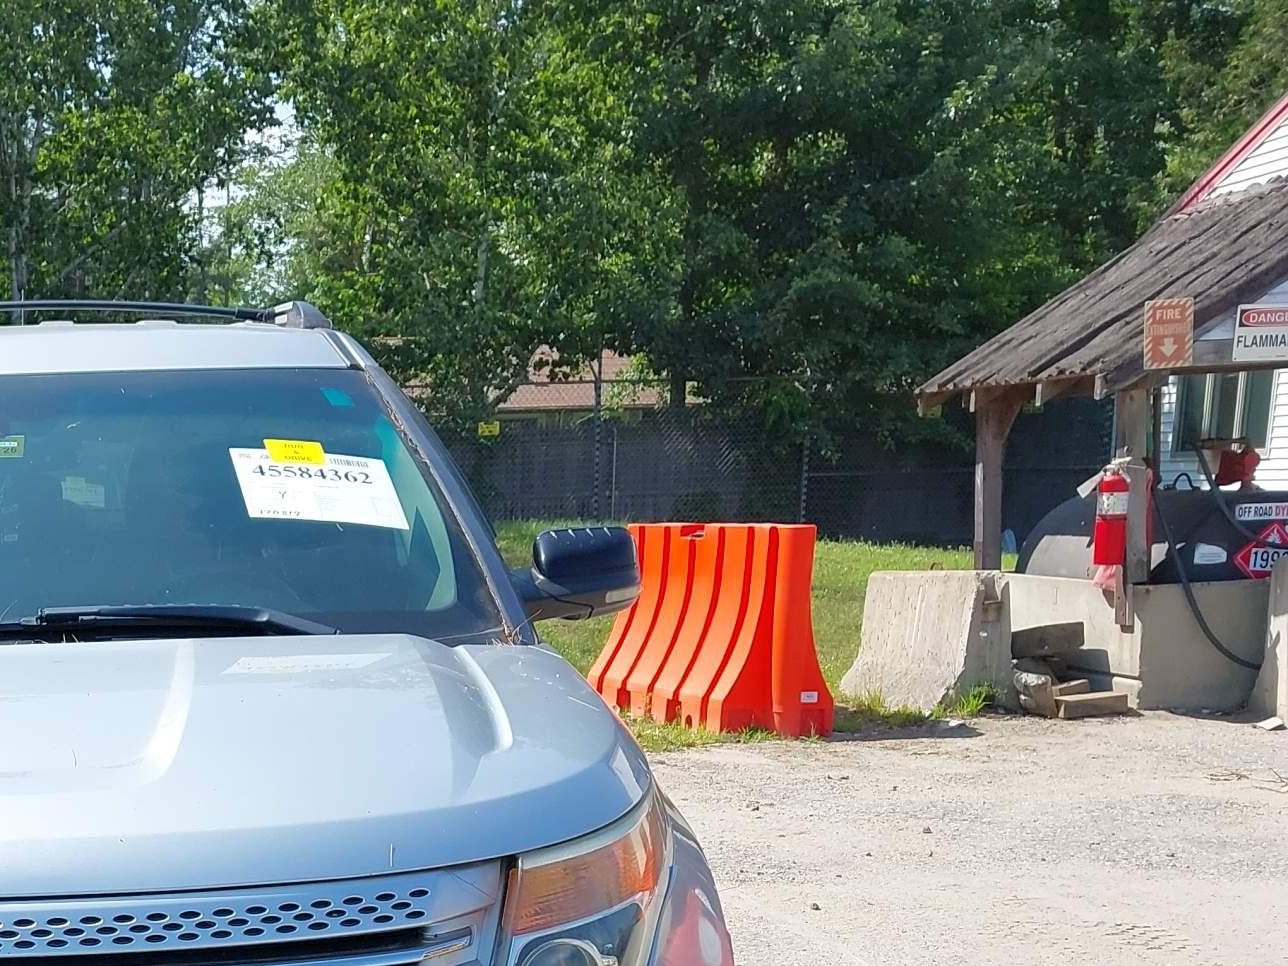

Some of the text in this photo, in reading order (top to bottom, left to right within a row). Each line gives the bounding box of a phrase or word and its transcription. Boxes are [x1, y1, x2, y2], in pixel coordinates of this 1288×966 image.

[1156, 308, 1182, 321] FIRE
[1236, 334, 1288, 348] FLAMMA
[252, 464, 373, 485] 45584362
[1238, 506, 1253, 518] OFF
[1254, 506, 1273, 517] ROAD
[1253, 550, 1288, 569] 199
